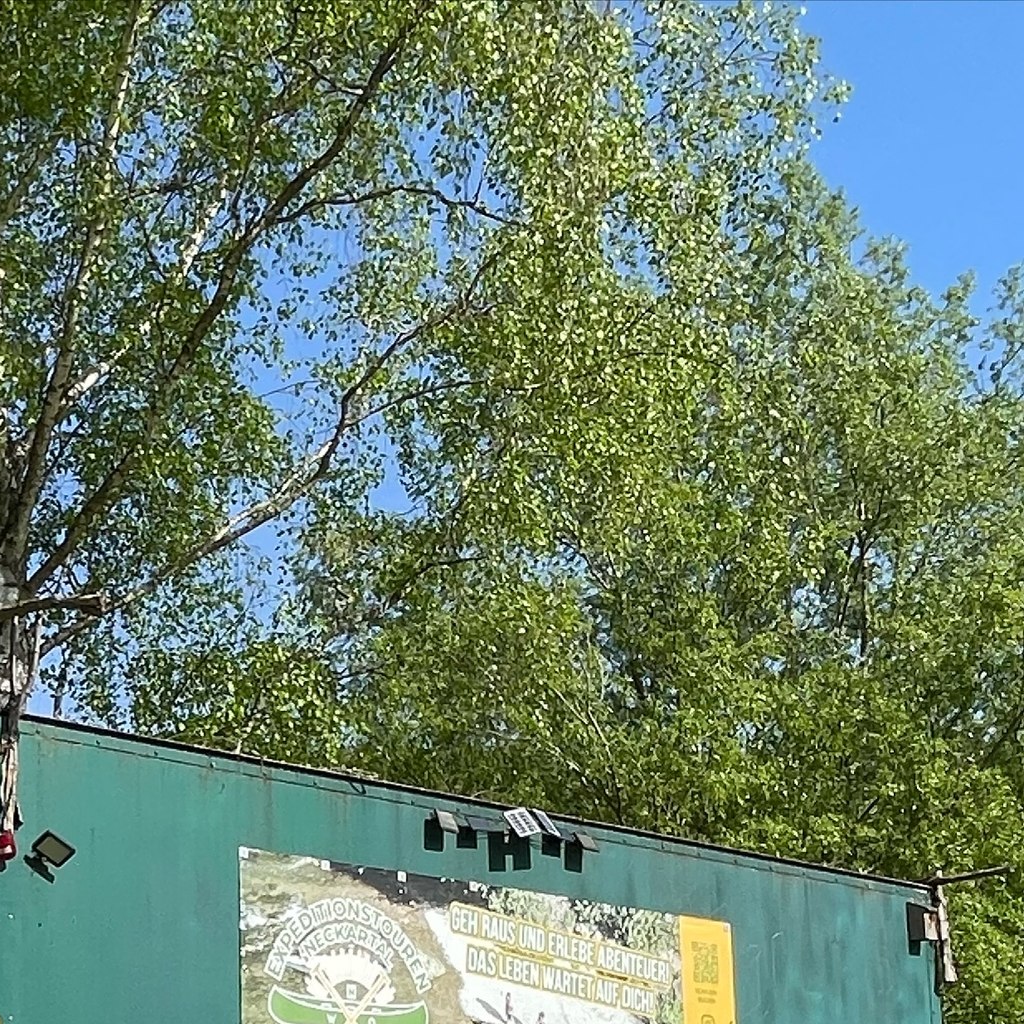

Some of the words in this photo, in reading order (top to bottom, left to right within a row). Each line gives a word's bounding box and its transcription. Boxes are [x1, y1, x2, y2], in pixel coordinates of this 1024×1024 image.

[266, 900, 430, 991] EXPEDITIONSTOUREN
[451, 905, 478, 935] GEH
[481, 913, 516, 946] RAUS
[518, 922, 545, 953] UND
[548, 930, 594, 966] ERLEBE
[597, 944, 670, 985] ABENTEUER!
[467, 946, 497, 976] DAS
[499, 954, 540, 987] LEBEN
[542, 964, 594, 1000] WARTET
[596, 979, 620, 1005] AUF
[621, 986, 654, 1014] DICH!
